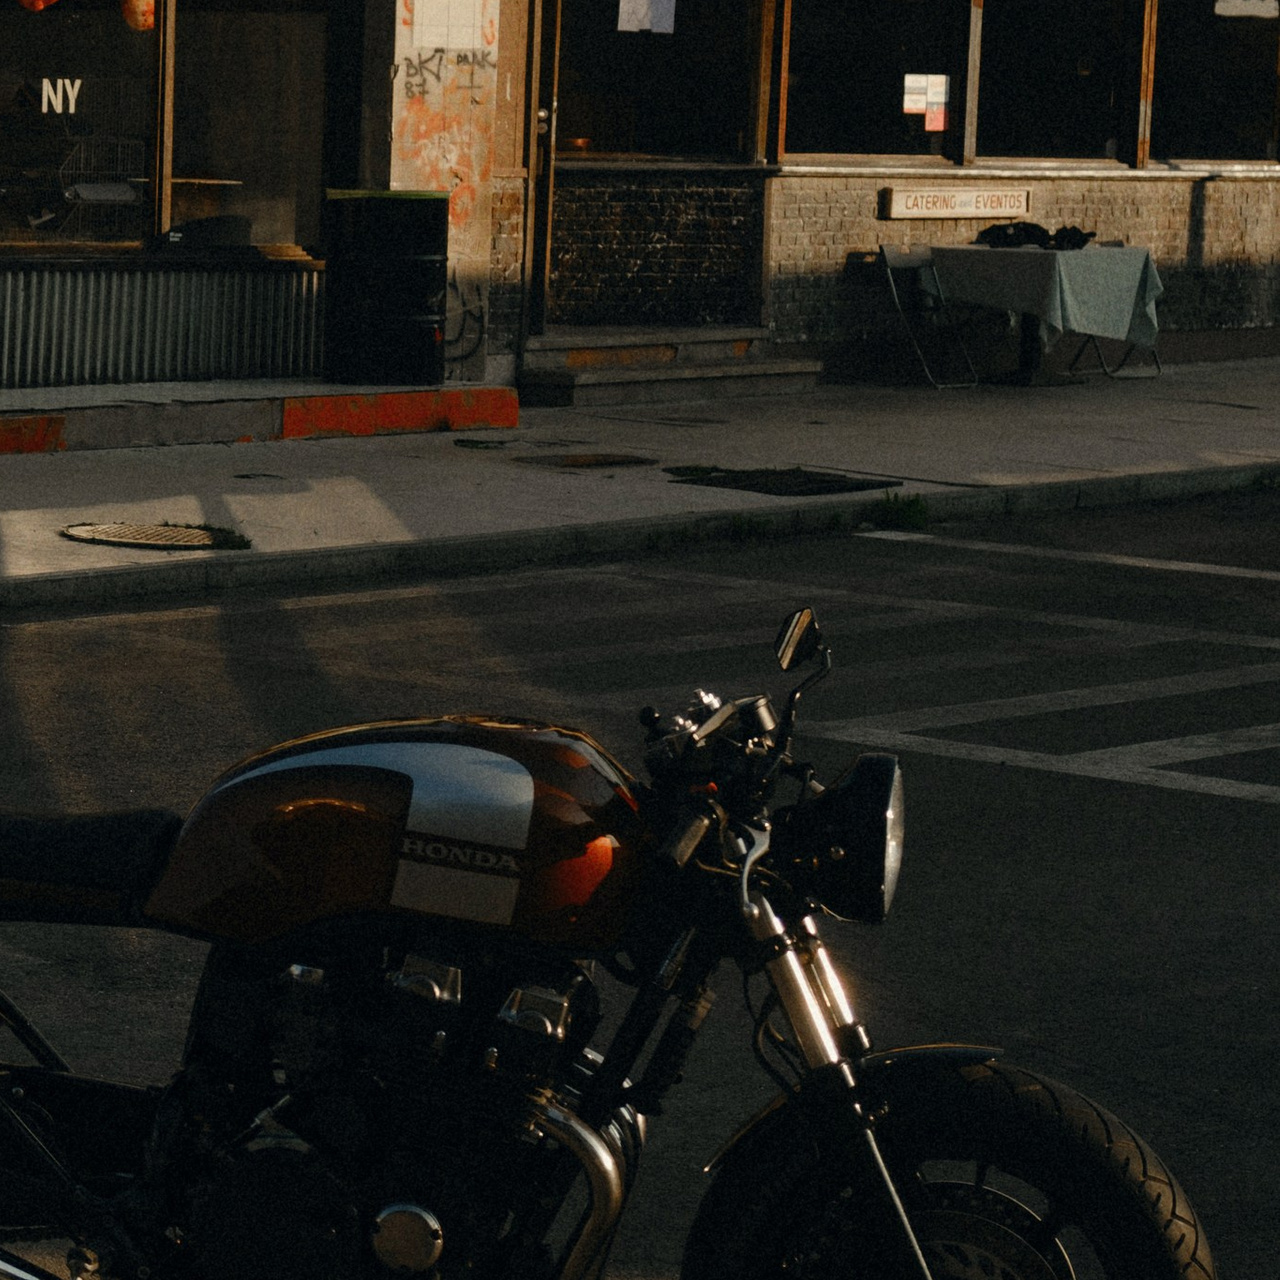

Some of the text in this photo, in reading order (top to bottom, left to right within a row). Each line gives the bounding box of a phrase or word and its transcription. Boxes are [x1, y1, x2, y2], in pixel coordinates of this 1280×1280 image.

[41, 77, 83, 114] NY
[905, 194, 956, 211] CATERING
[975, 193, 1023, 210] EVENTOS
[401, 838, 520, 871] HONDA
